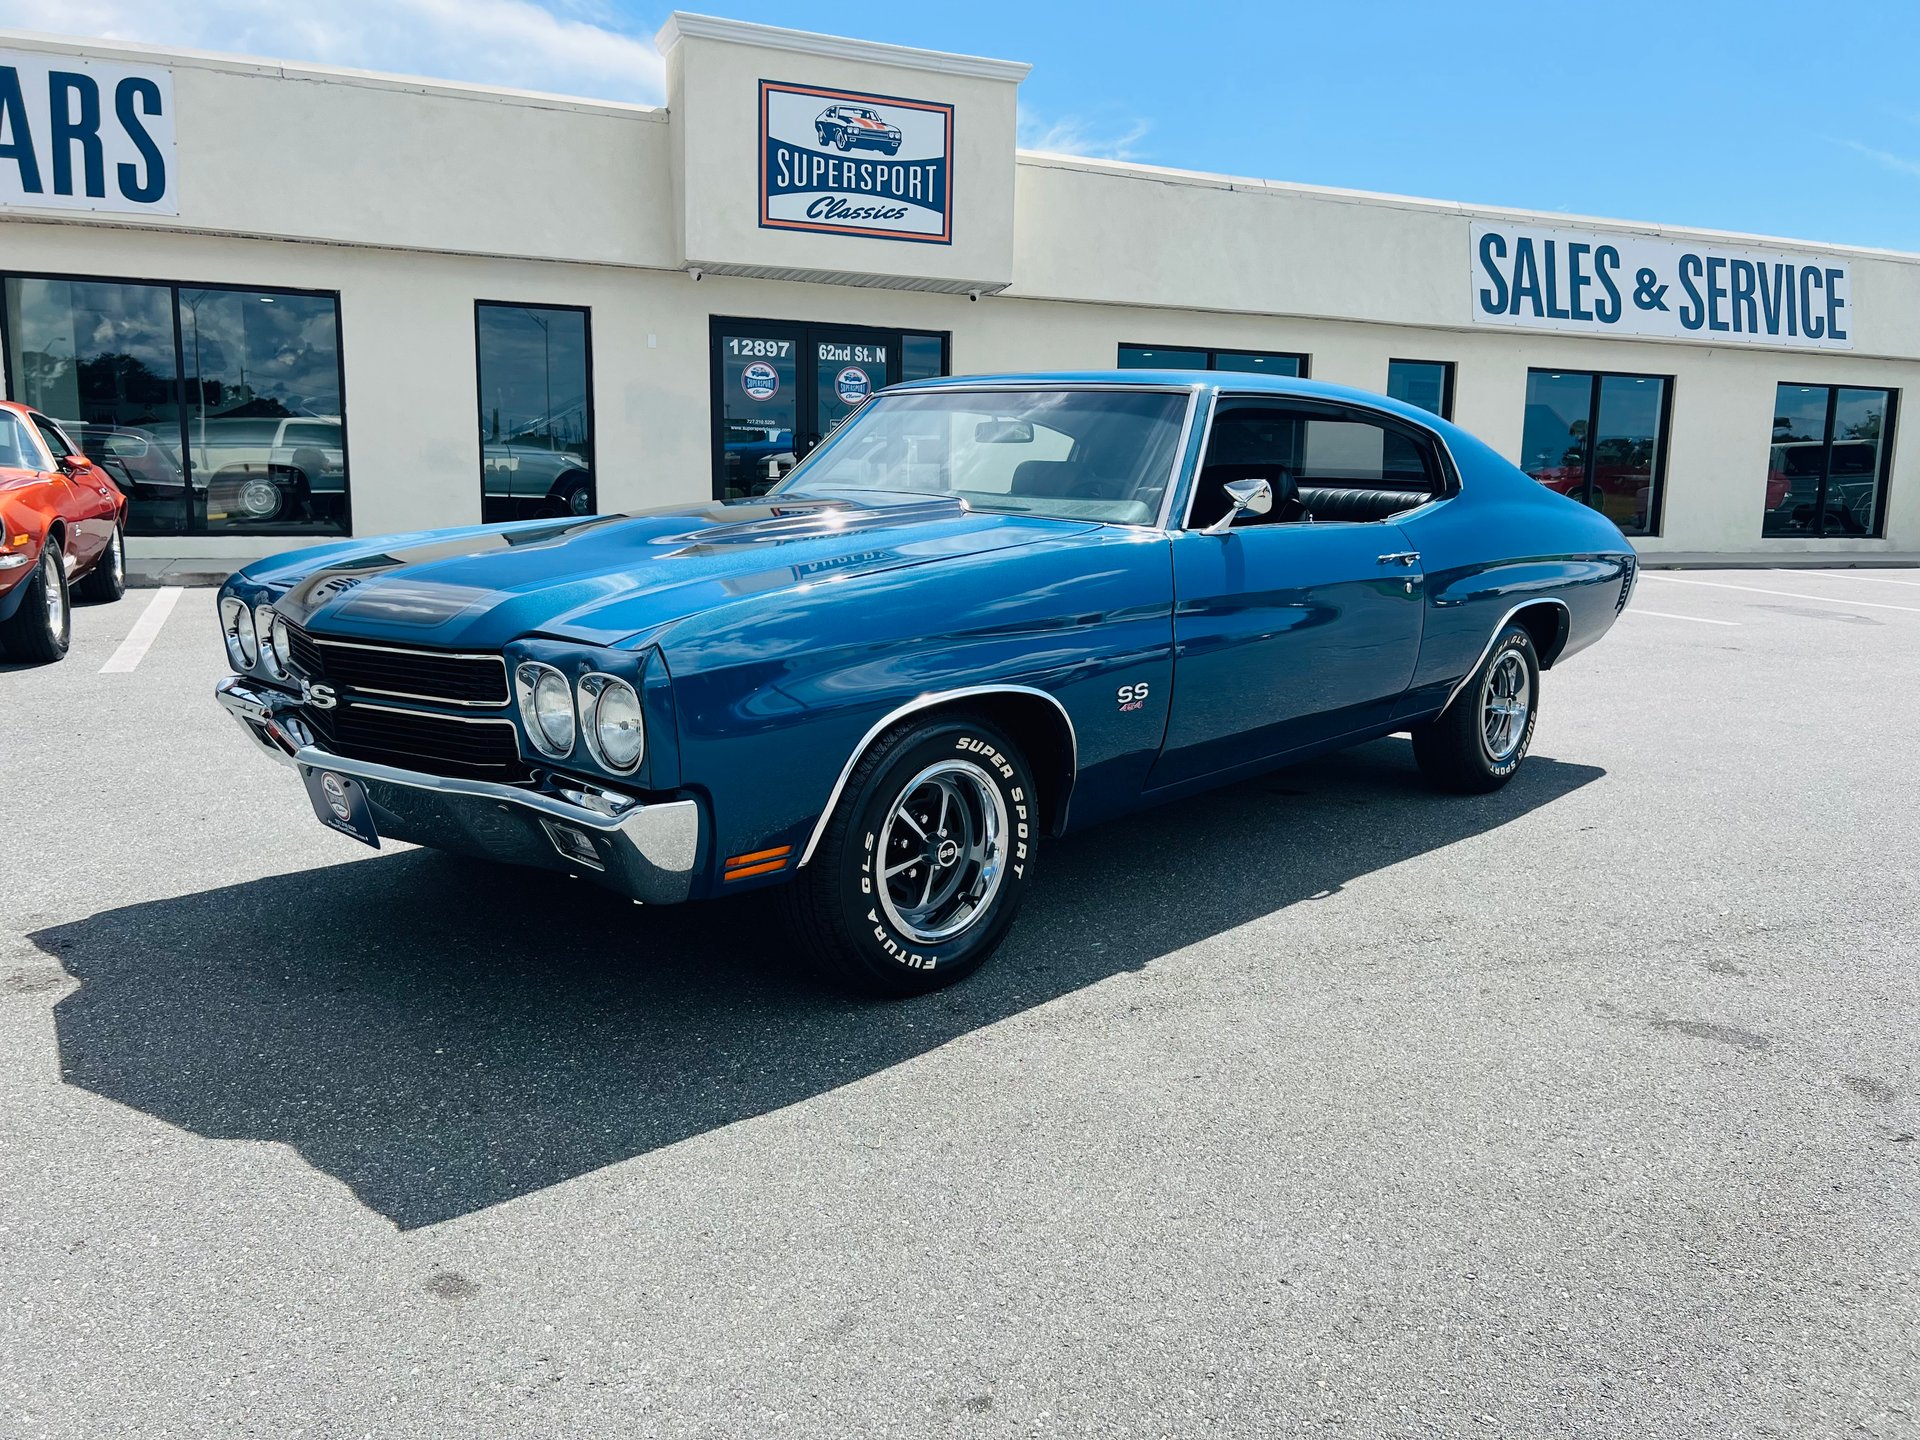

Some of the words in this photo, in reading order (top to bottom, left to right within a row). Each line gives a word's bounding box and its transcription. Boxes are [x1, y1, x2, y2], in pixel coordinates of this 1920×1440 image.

[777, 148, 937, 202] SUPERSPORT
[806, 196, 908, 220] Classics
[1479, 233, 1622, 324] SALES
[1633, 267, 1670, 312] &
[1679, 253, 1847, 340] SERVICE
[729, 339, 790, 357] 12897
[818, 344, 851, 361] 62nd
[854, 346, 872, 363] St.
[876, 347, 886, 363] N
[747, 378, 774, 388] SUPERSPORT
[840, 383, 866, 393] SUPERSPORT
[1511, 635, 1528, 647] GLS
[1117, 682, 1149, 704] SS
[1517, 711, 1536, 761] SUPER
[1490, 760, 1516, 776] SPORT
[956, 737, 1014, 778] SUPER
[1011, 786, 1029, 880] SPORT
[861, 831, 874, 894] GLS
[867, 908, 938, 970] FUTURA
